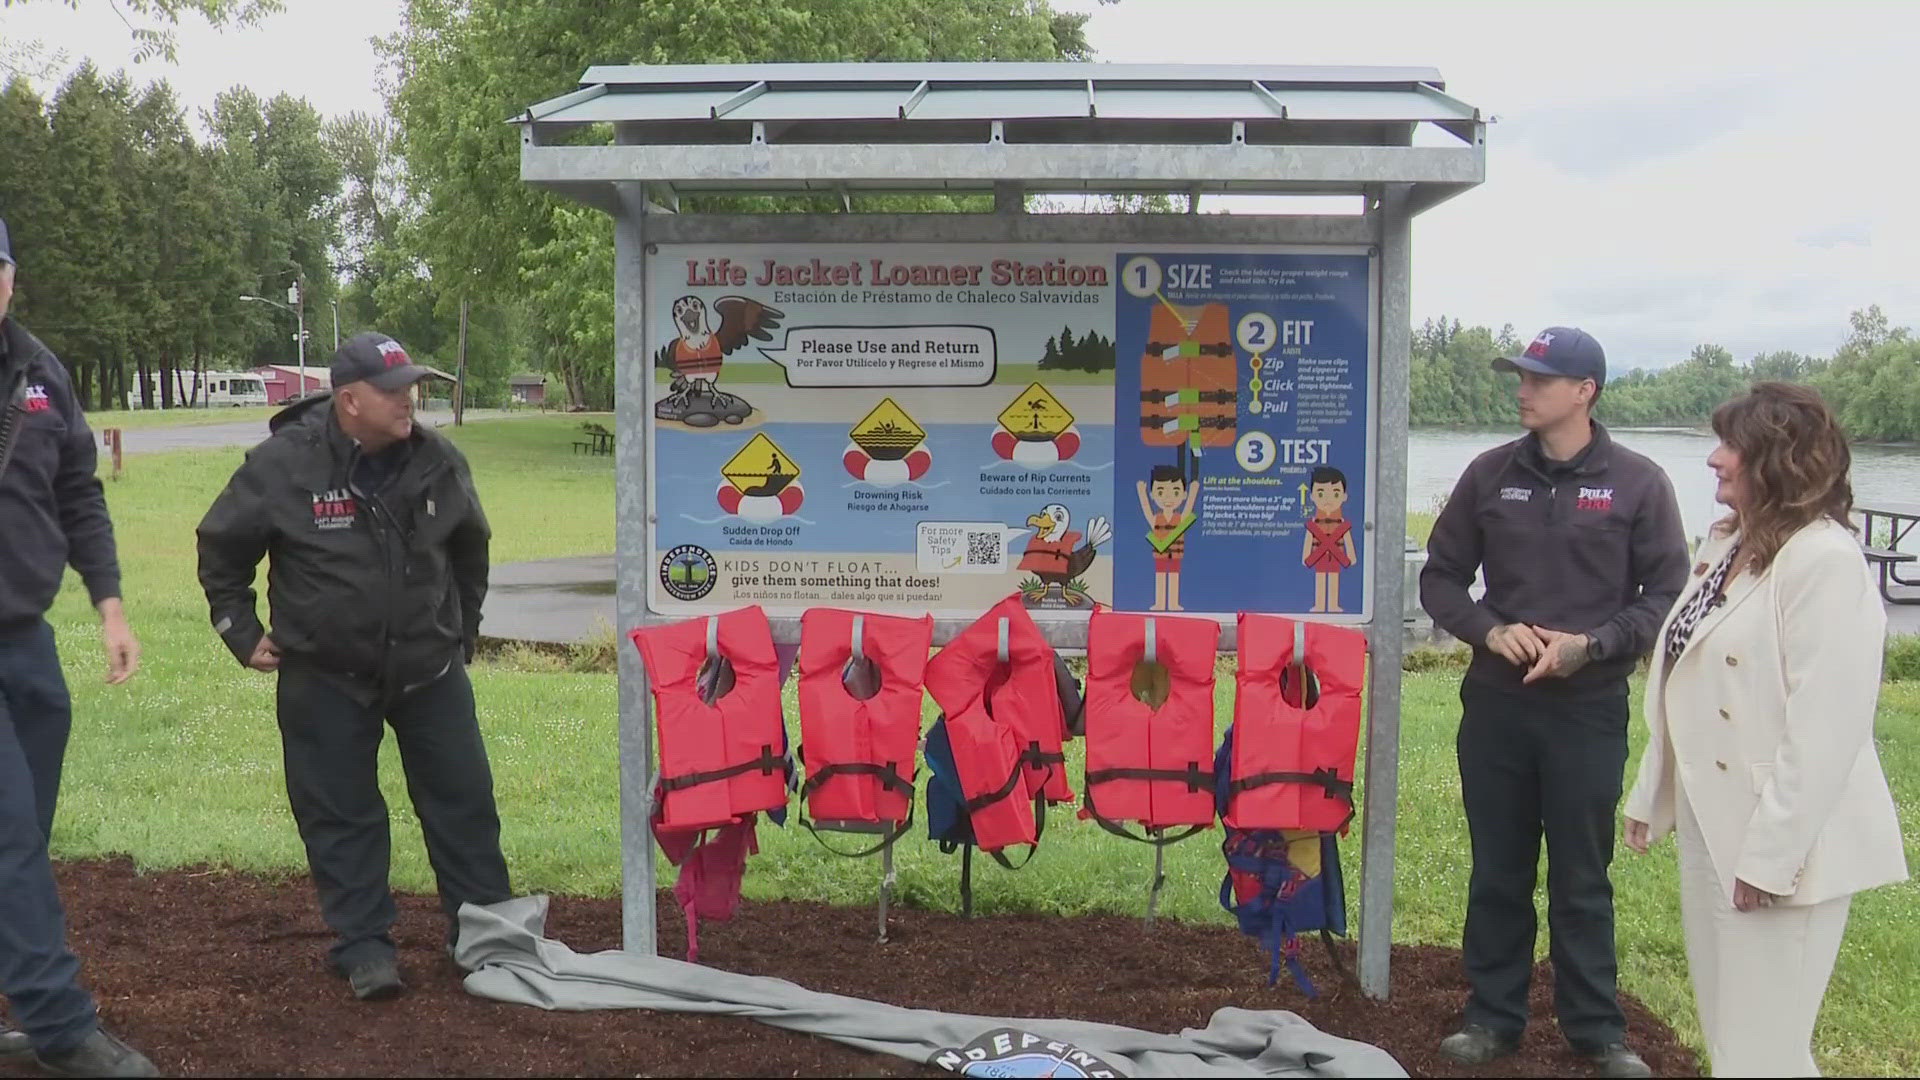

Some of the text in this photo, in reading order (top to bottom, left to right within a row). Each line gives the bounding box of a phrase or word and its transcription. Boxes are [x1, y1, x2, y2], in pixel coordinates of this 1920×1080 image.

[686, 258, 1109, 287] Life Jacket Loaner Station
[1135, 265, 1148, 289] 1
[1167, 264, 1212, 289] SIZE
[1219, 268, 1239, 276] Check
[1240, 268, 1252, 276] the
[1253, 268, 1270, 276] label
[1270, 268, 1281, 276] for
[1281, 269, 1304, 278] proper
[1305, 268, 1328, 278] weight
[1219, 276, 1233, 284] and
[1268, 277, 1279, 286] Try
[774, 290, 1099, 303] Estación de Préstamo de Chaleco Salvavidas
[1248, 321, 1265, 345] 2
[1283, 320, 1314, 345] FIT
[801, 340, 980, 354] Please Use and Return
[797, 358, 813, 368] Por
[815, 358, 843, 368] Favor
[889, 360, 896, 370] y
[898, 358, 937, 370] Regrese
[939, 358, 948, 368] el
[950, 359, 985, 368] Mismo
[1263, 358, 1284, 372] Zip
[1333, 358, 1349, 367] clips
[1263, 379, 1295, 392] Click
[1263, 401, 1289, 413] Pull
[1248, 440, 1264, 463] 3
[1281, 439, 1331, 465] TEST
[980, 473, 1091, 484] Beware of Rip Currents
[1203, 477, 1217, 485] Lift
[1228, 477, 1241, 485] the
[1242, 477, 1283, 486] shoulders.
[854, 490, 923, 501] Drowning Risk
[980, 487, 1014, 495] Cuidado
[1033, 487, 1045, 495] las
[1047, 487, 1091, 495] Corrientes
[1203, 495, 1209, 503] If
[1209, 495, 1231, 503] there's
[1251, 495, 1267, 503] than
[1282, 497, 1296, 505] gap
[1577, 499, 1612, 511] FIRE
[847, 503, 929, 512] Riesgo de Ahogarse
[1203, 503, 1231, 511] between
[1232, 503, 1265, 511] shoulders
[1203, 511, 1214, 519] life
[1214, 511, 1237, 520] jacket,
[1238, 511, 1248, 519] it's
[1261, 511, 1274, 520] big!
[722, 526, 800, 536] Sudden Drop Off
[921, 526, 963, 535] For more
[766, 538, 793, 546] Hondo
[927, 536, 957, 546] Safety
[930, 546, 951, 555] Tips
[661, 546, 716, 576] INDEPENDENCE
[723, 560, 898, 574] KIDS DON'T FLOAT...
[731, 574, 940, 589] give them something that does!
[753, 590, 778, 599] niños
[830, 592, 854, 600] dales
[856, 592, 876, 601] algo
[877, 593, 894, 602] que
